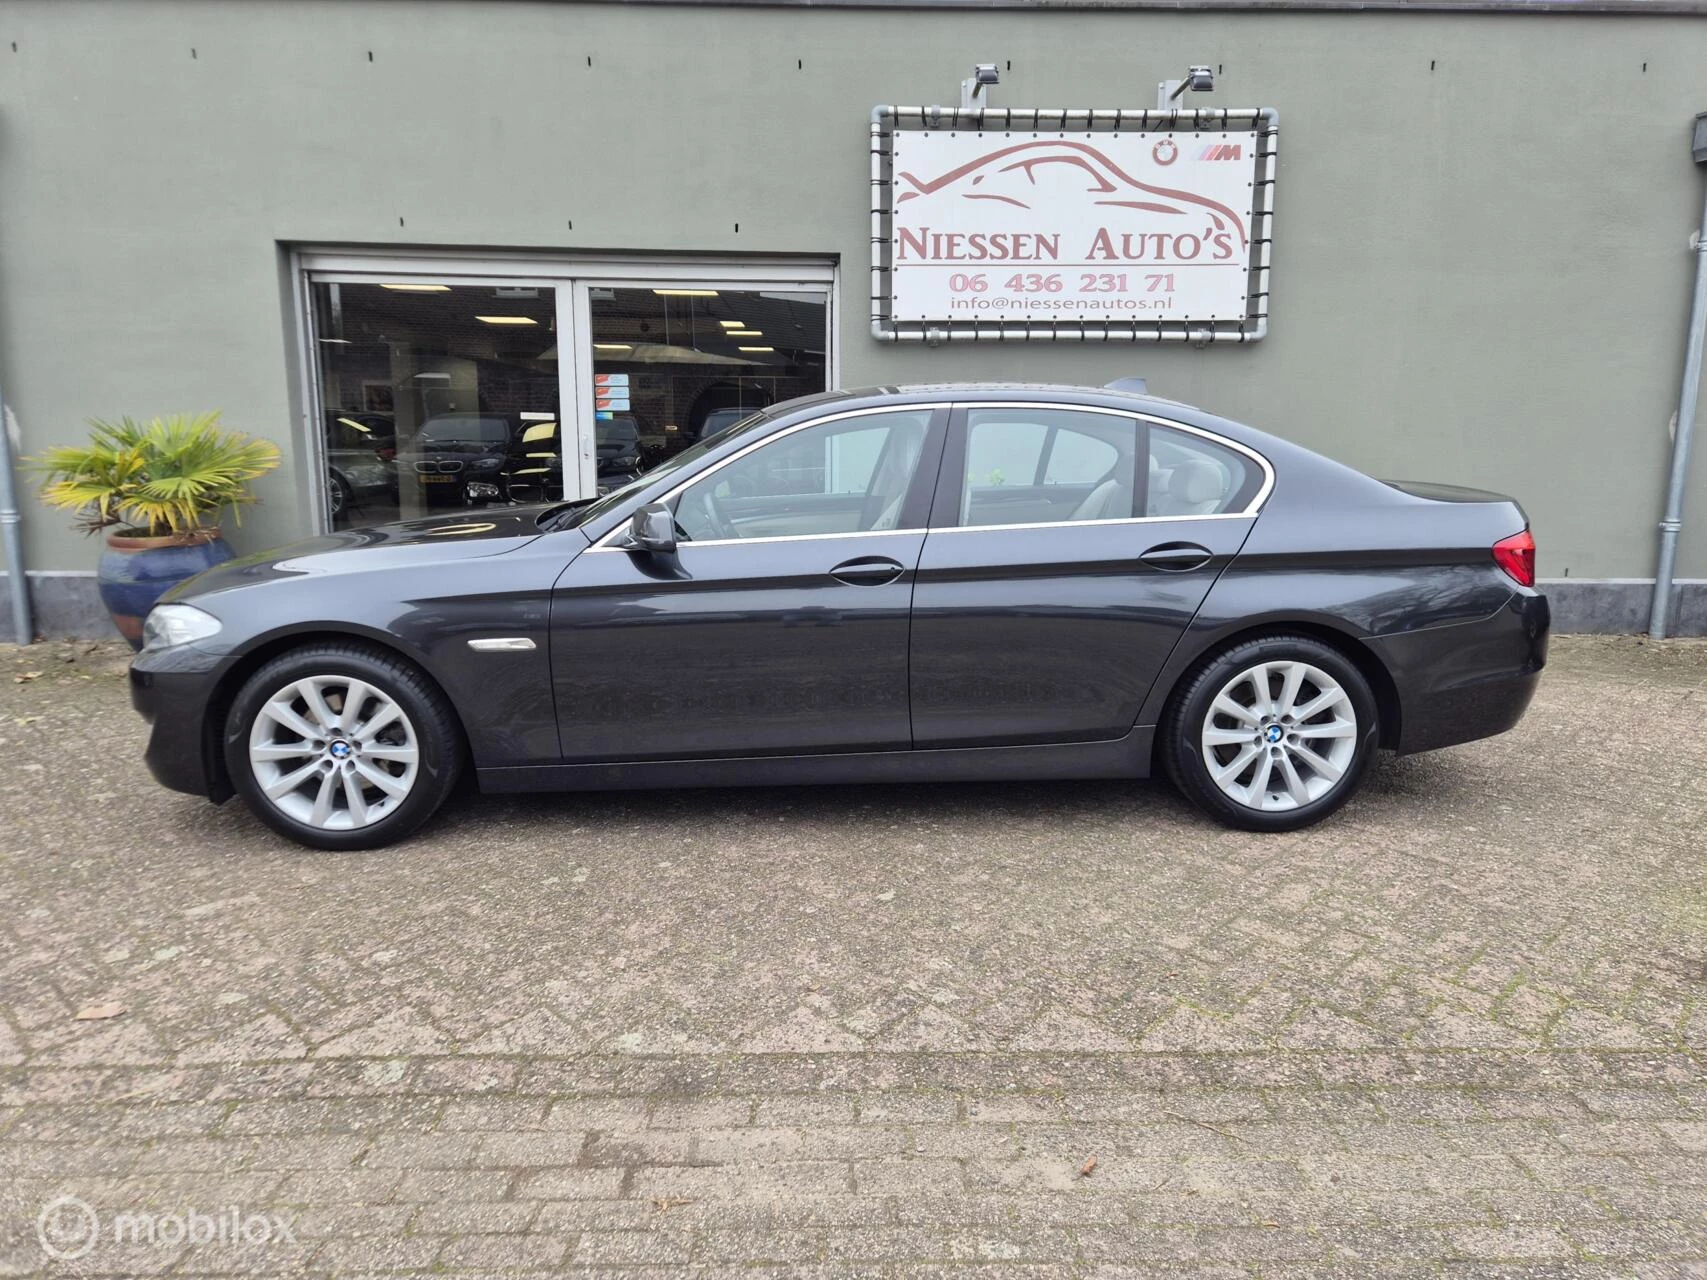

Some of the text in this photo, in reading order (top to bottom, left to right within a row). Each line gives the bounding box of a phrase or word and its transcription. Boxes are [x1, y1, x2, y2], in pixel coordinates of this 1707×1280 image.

[896, 226, 1061, 260] NIESSEN
[949, 273, 1176, 293] 06 436 231 71
[951, 296, 1172, 310] info@niessenautos.nl
